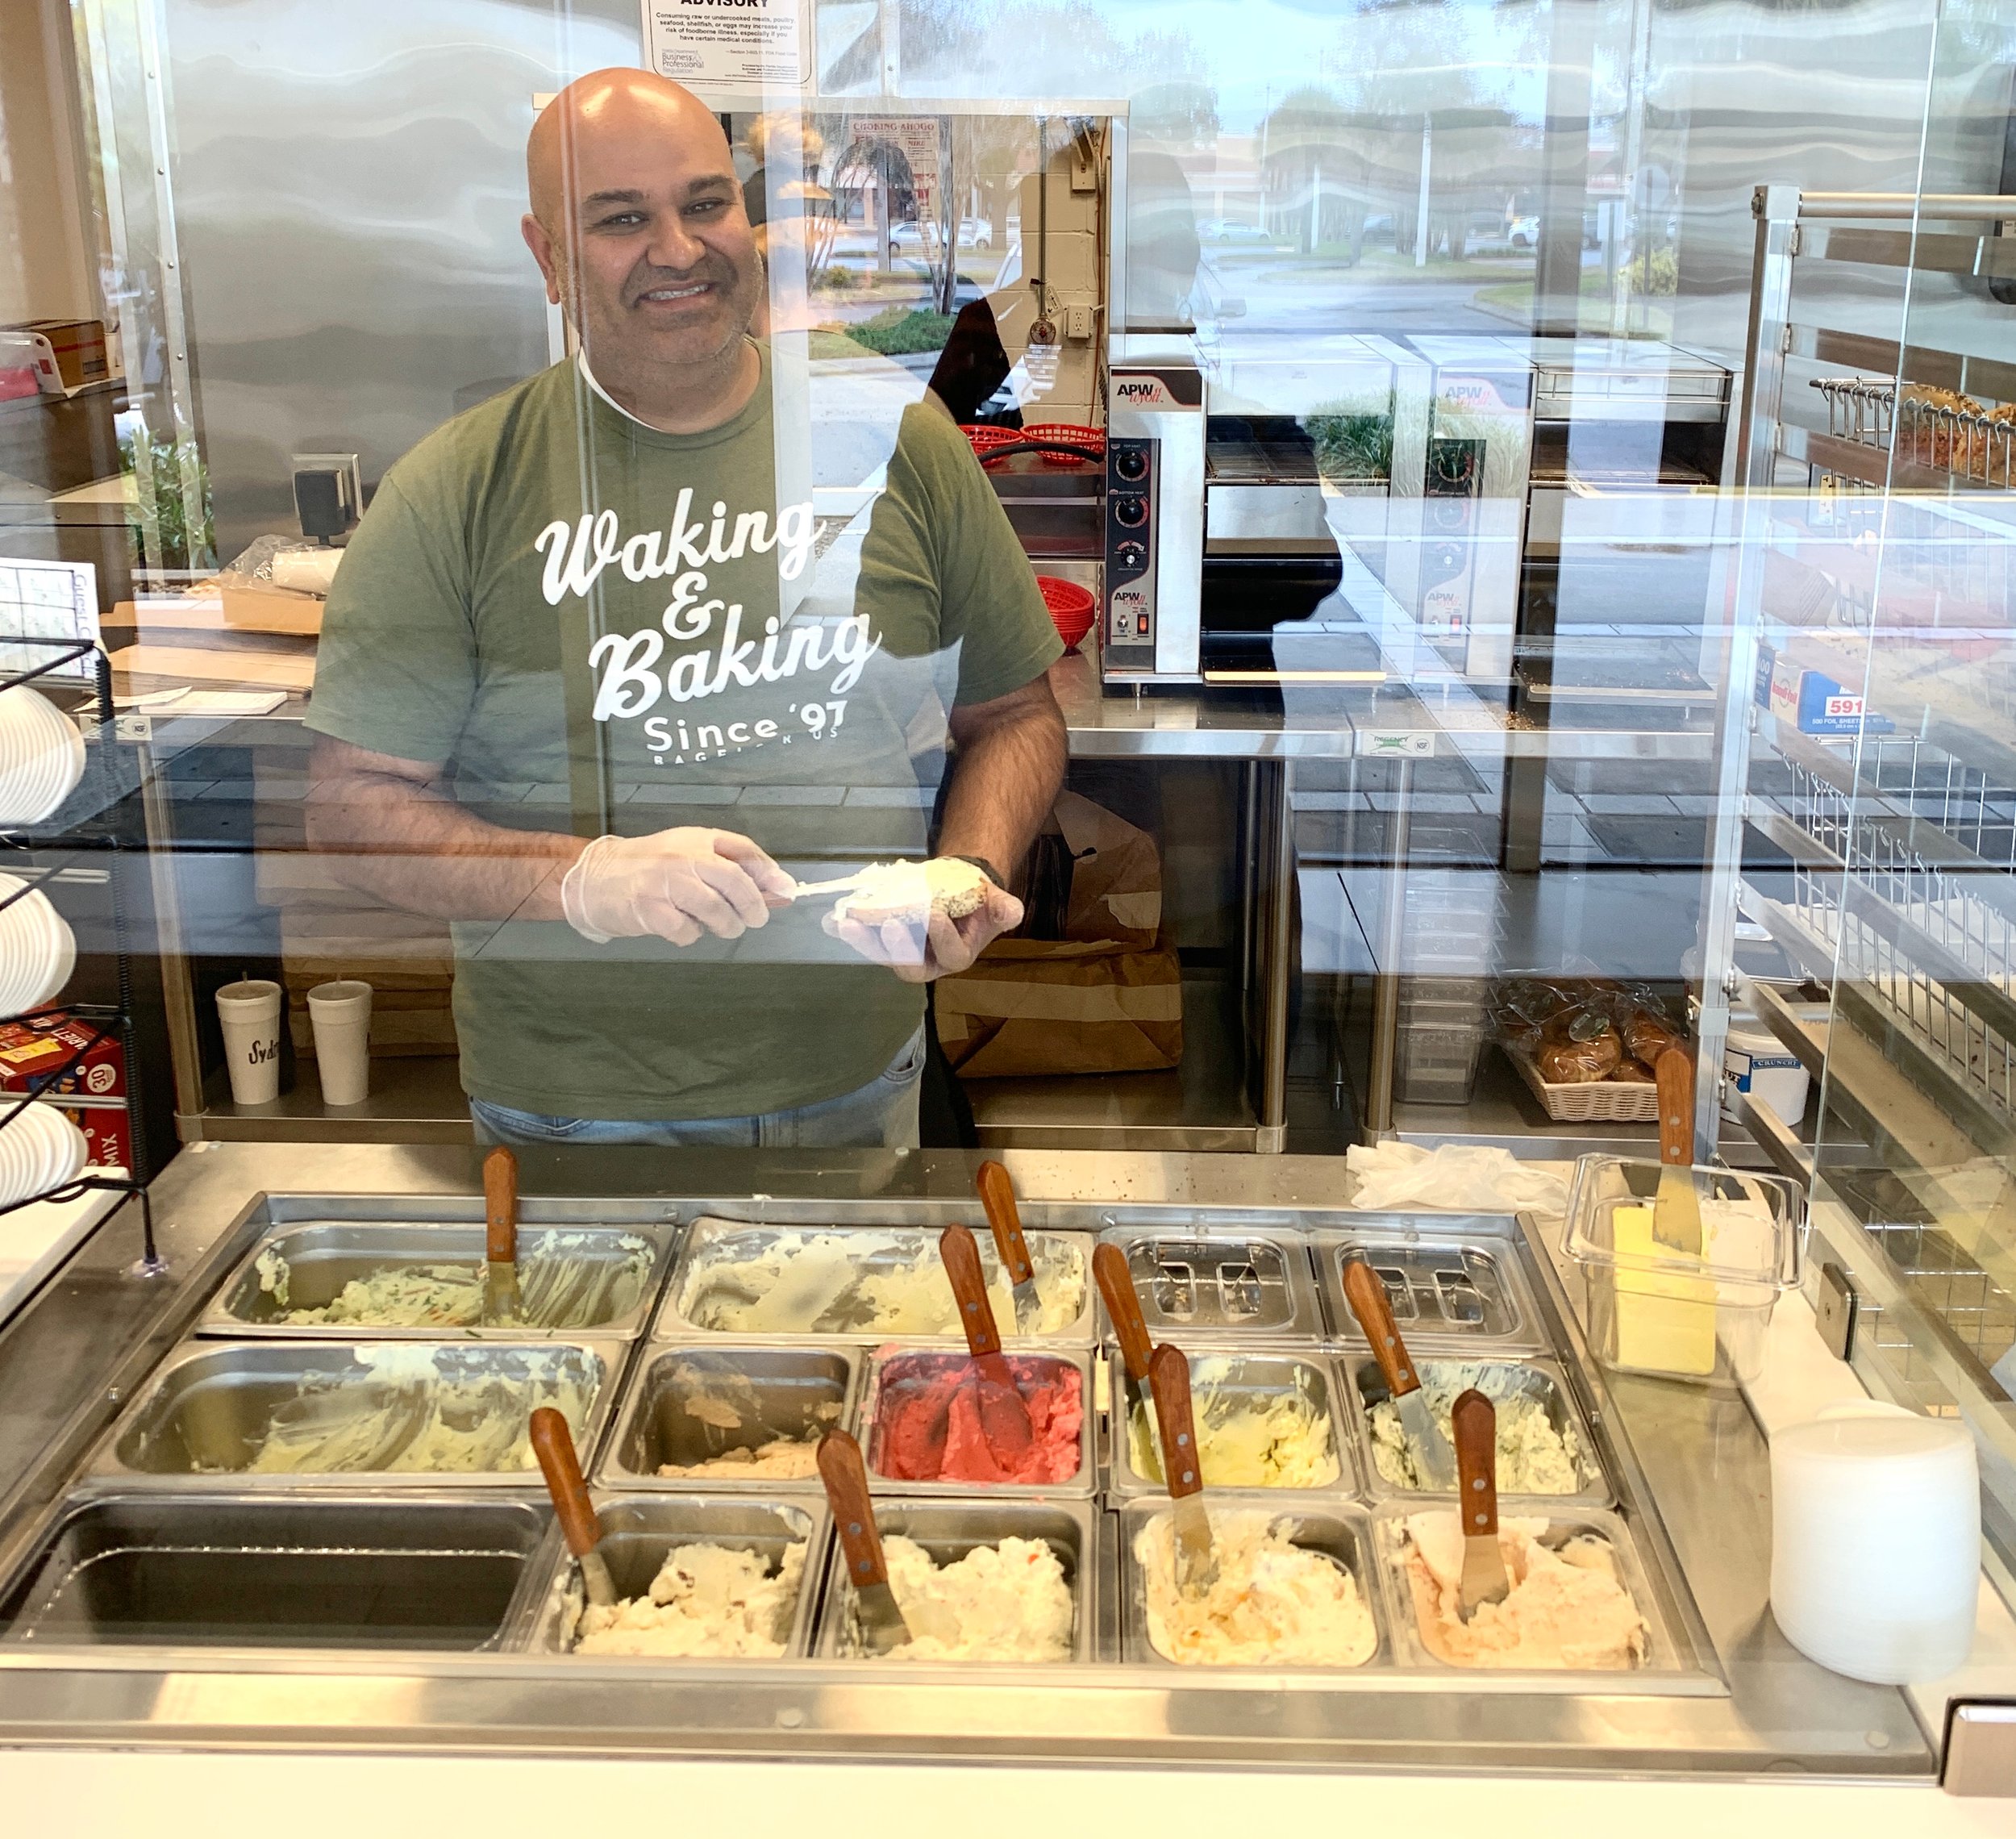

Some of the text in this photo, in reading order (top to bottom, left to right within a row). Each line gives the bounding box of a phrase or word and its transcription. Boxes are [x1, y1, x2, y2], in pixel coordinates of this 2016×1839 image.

[656, 12, 690, 20] Consuming
[662, 52, 692, 61] Business
[662, 59, 704, 69] Professional
[853, 123, 935, 131] CHOKING AHOGO
[1117, 384, 1154, 396] APW
[1445, 386, 1482, 398] APW
[535, 488, 827, 606] Waking
[1114, 592, 1140, 601] APW
[1427, 593, 1454, 601] APW
[662, 571, 725, 640] &
[589, 604, 883, 722] Baking
[644, 716, 779, 752] Since
[1416, 742, 1428, 750] NSF
[91, 1069, 107, 1089] 30
[101, 1132, 120, 1167] MIX
